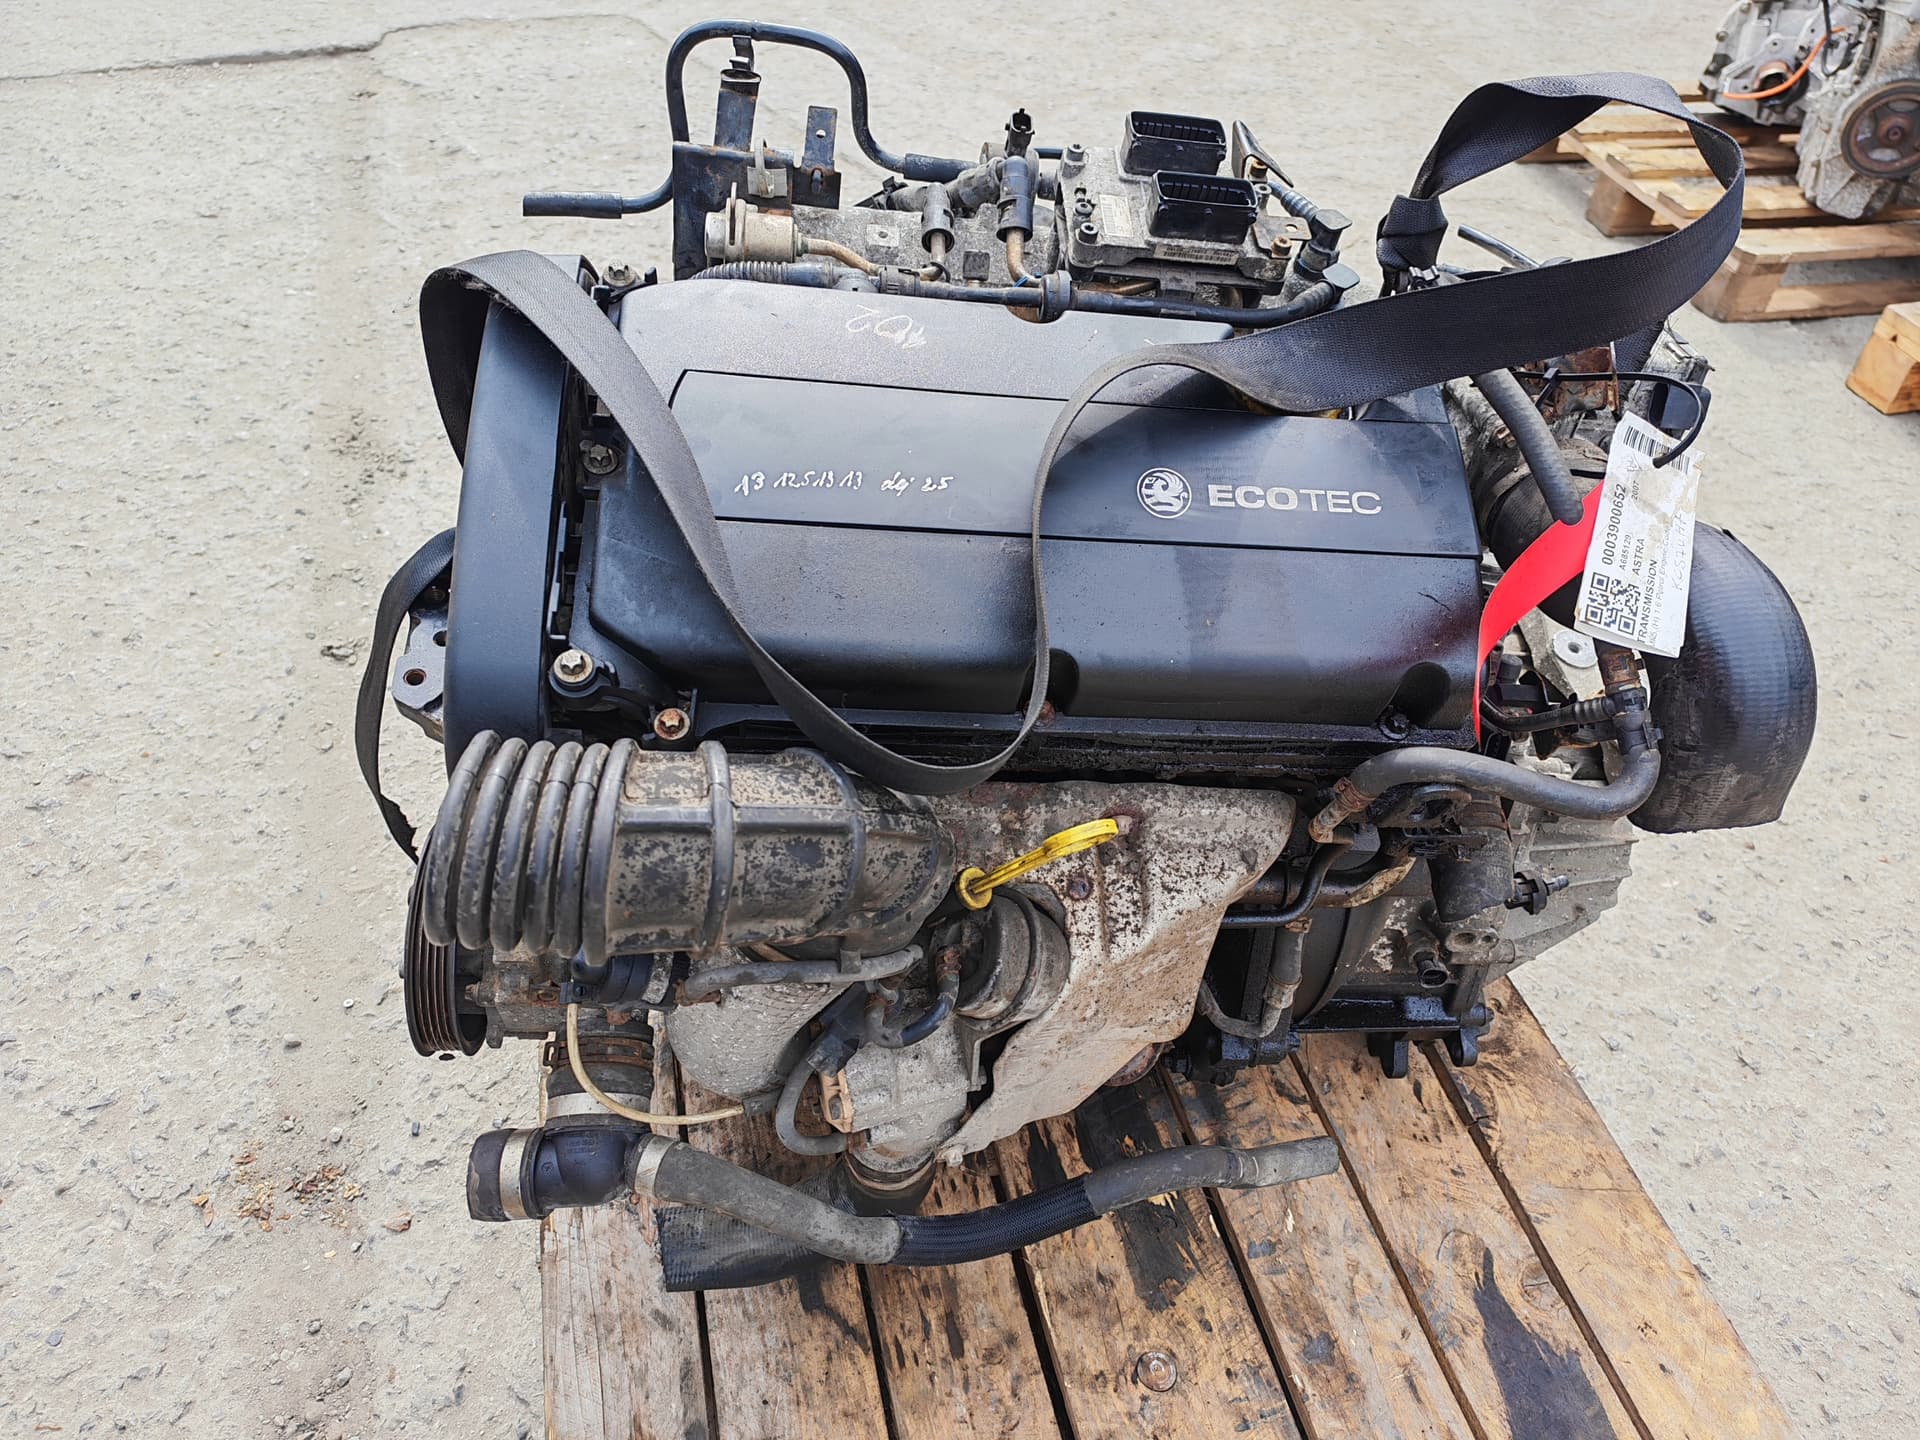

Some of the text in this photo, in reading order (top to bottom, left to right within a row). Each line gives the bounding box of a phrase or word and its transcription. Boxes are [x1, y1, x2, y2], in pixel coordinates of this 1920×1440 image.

[1207, 484, 1383, 515] ECOTEC
[1631, 480, 1640, 500] 2007
[1602, 483, 1626, 566] 0003900652
[1619, 534, 1632, 571] A685129
[1631, 538, 1645, 576] ASTRA
[1636, 559, 1658, 643] TRANSMISSION
